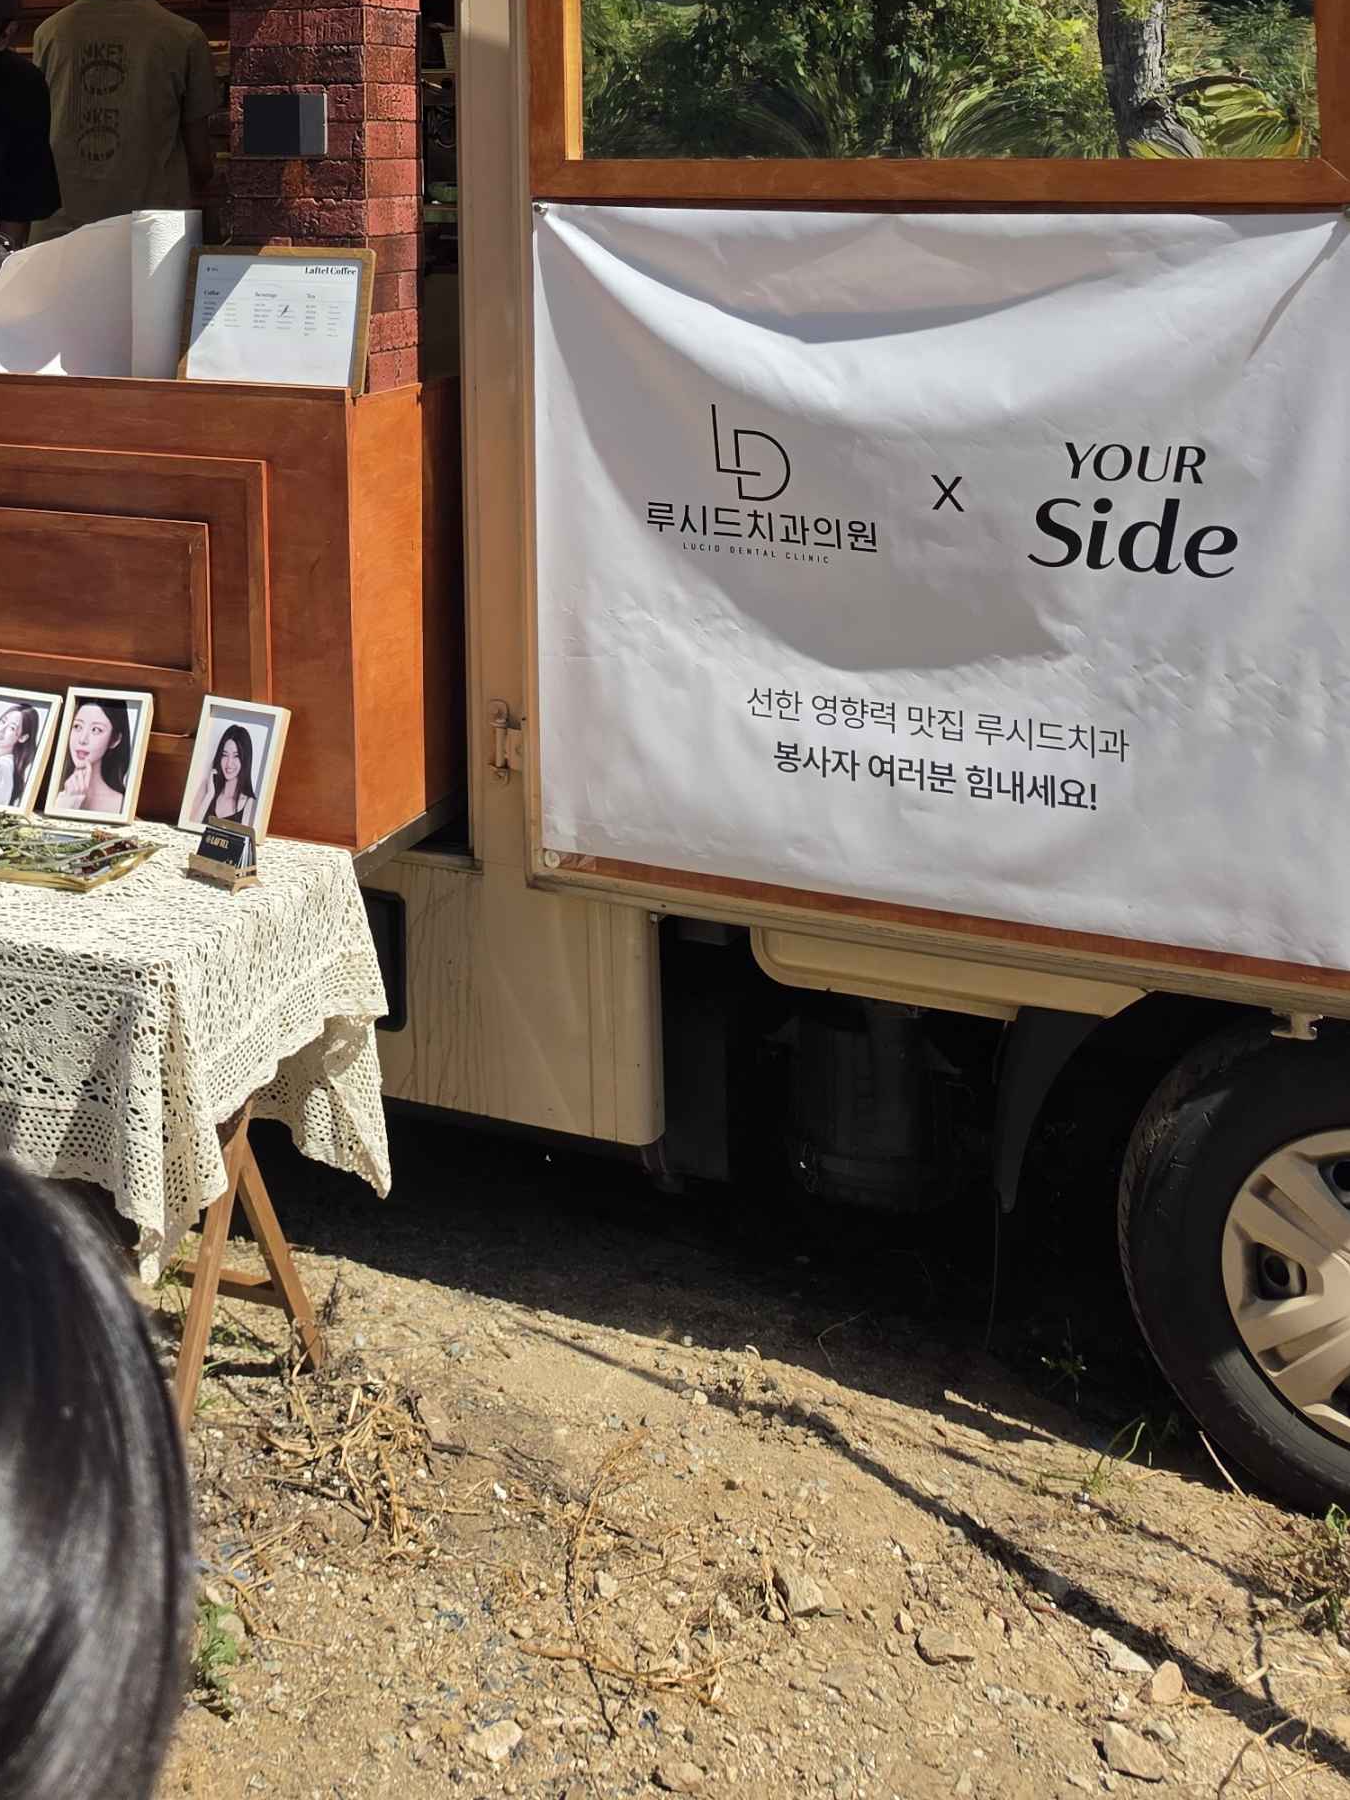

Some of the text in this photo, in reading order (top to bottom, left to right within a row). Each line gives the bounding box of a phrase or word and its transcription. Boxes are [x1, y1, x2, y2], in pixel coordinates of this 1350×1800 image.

[330, 266, 357, 276] Coffee
[1064, 441, 1207, 485] YOUR
[646, 501, 879, 553] 루시드치과의원
[683, 541, 831, 565] LUCID DENTAL CLINIC
[1026, 497, 1239, 579] Side
[746, 686, 1131, 763] 선한 영향력 맛집 루시드치과
[773, 741, 1098, 811] 봉사자 여러분 힘내세요!
